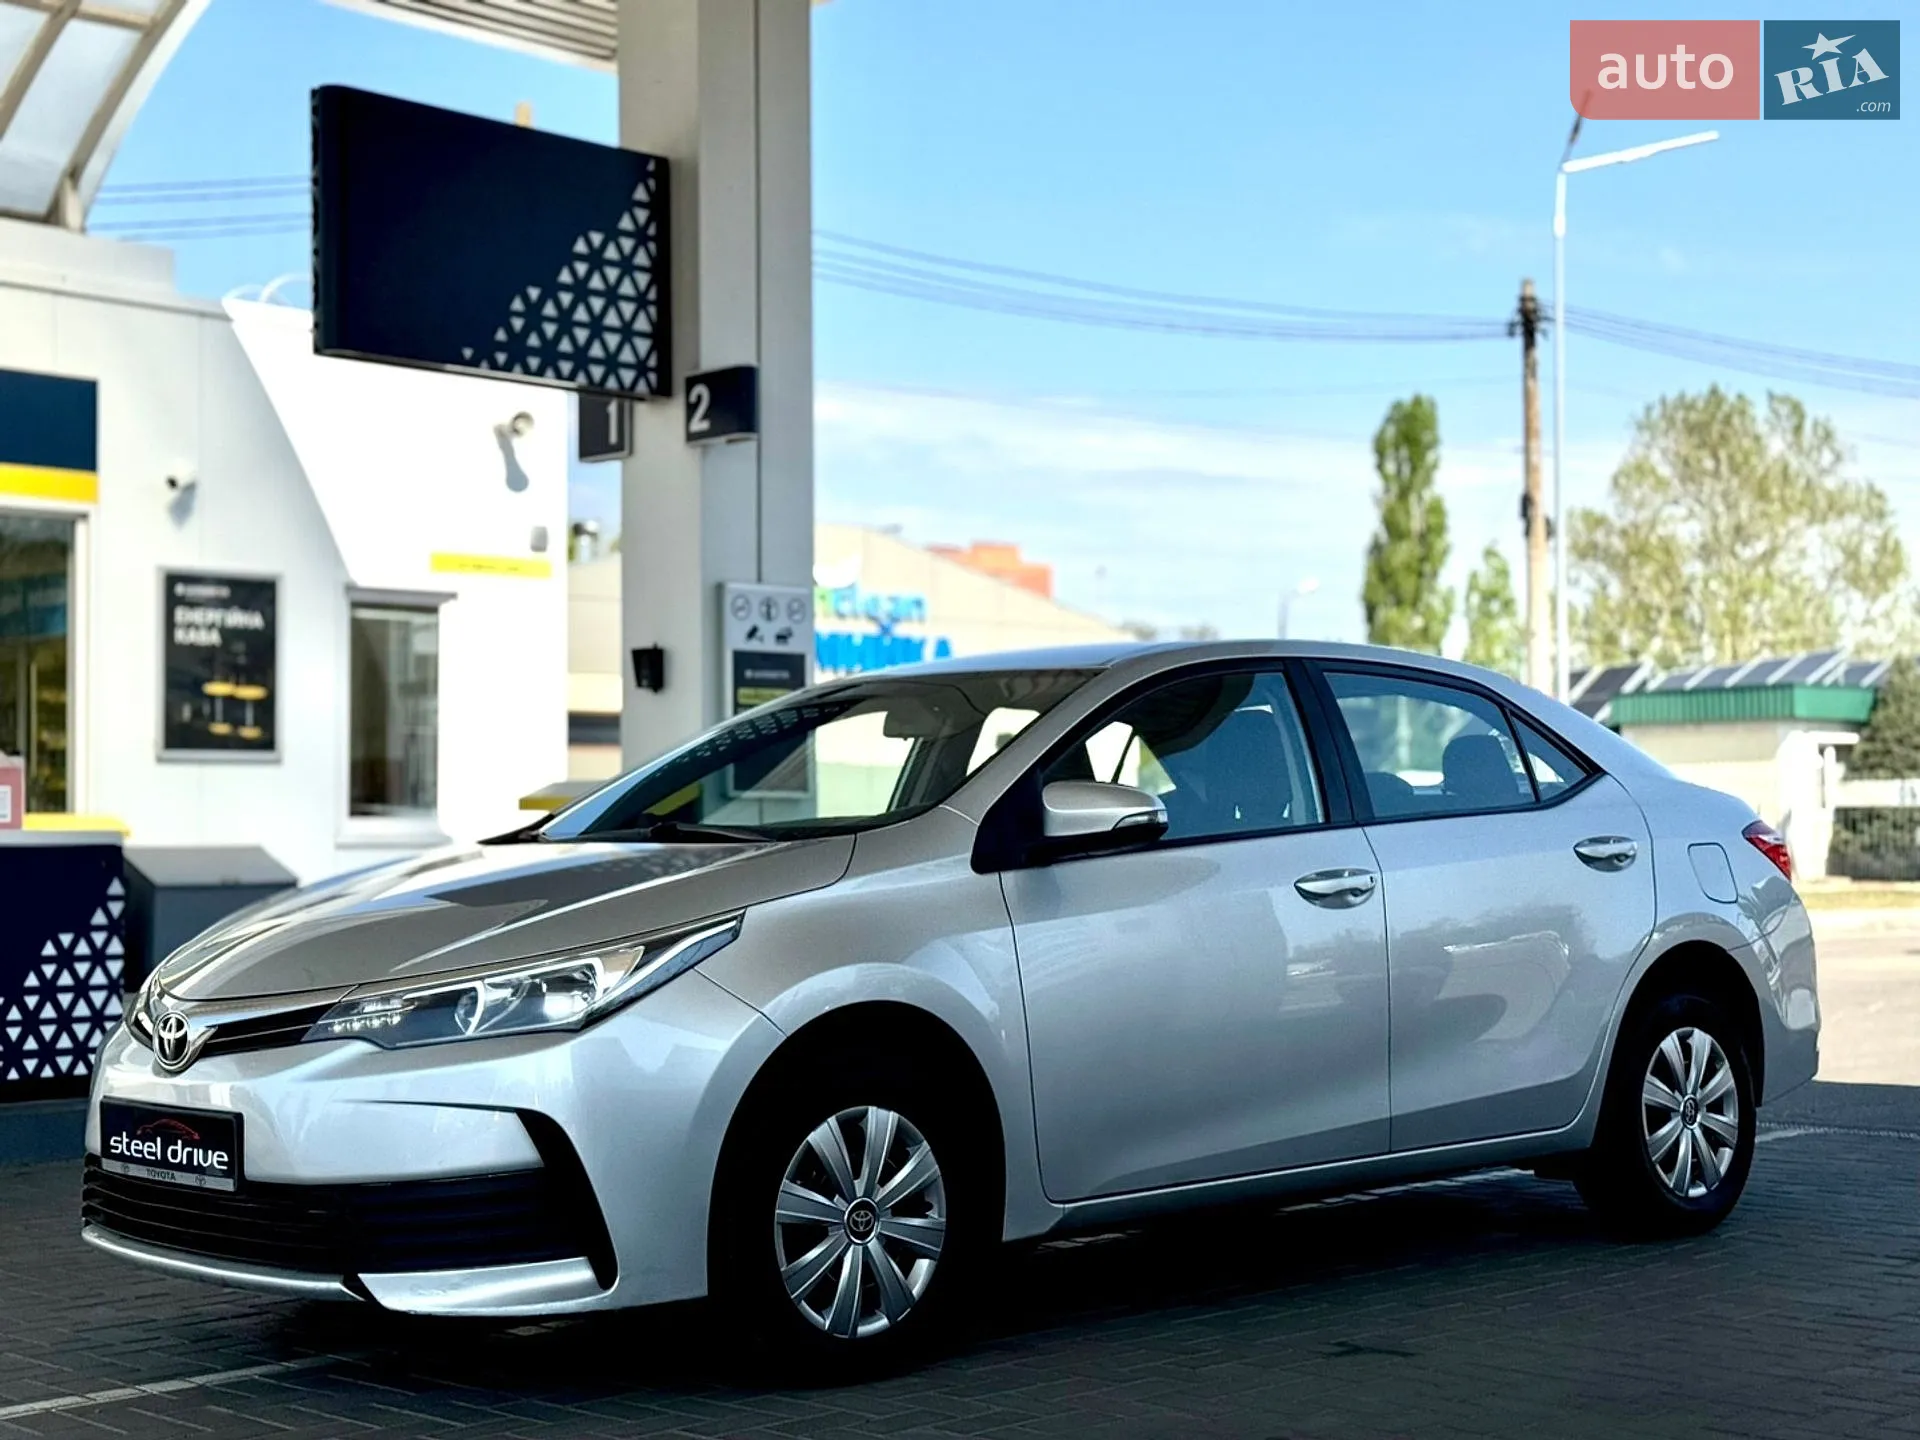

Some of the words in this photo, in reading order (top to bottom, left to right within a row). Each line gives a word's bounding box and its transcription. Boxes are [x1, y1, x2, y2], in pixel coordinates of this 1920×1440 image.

[606, 398, 618, 445] 1
[689, 383, 711, 433] 2
[109, 1130, 161, 1161] steel
[167, 1138, 229, 1170] drive
[145, 1166, 177, 1182] TOYOTA
